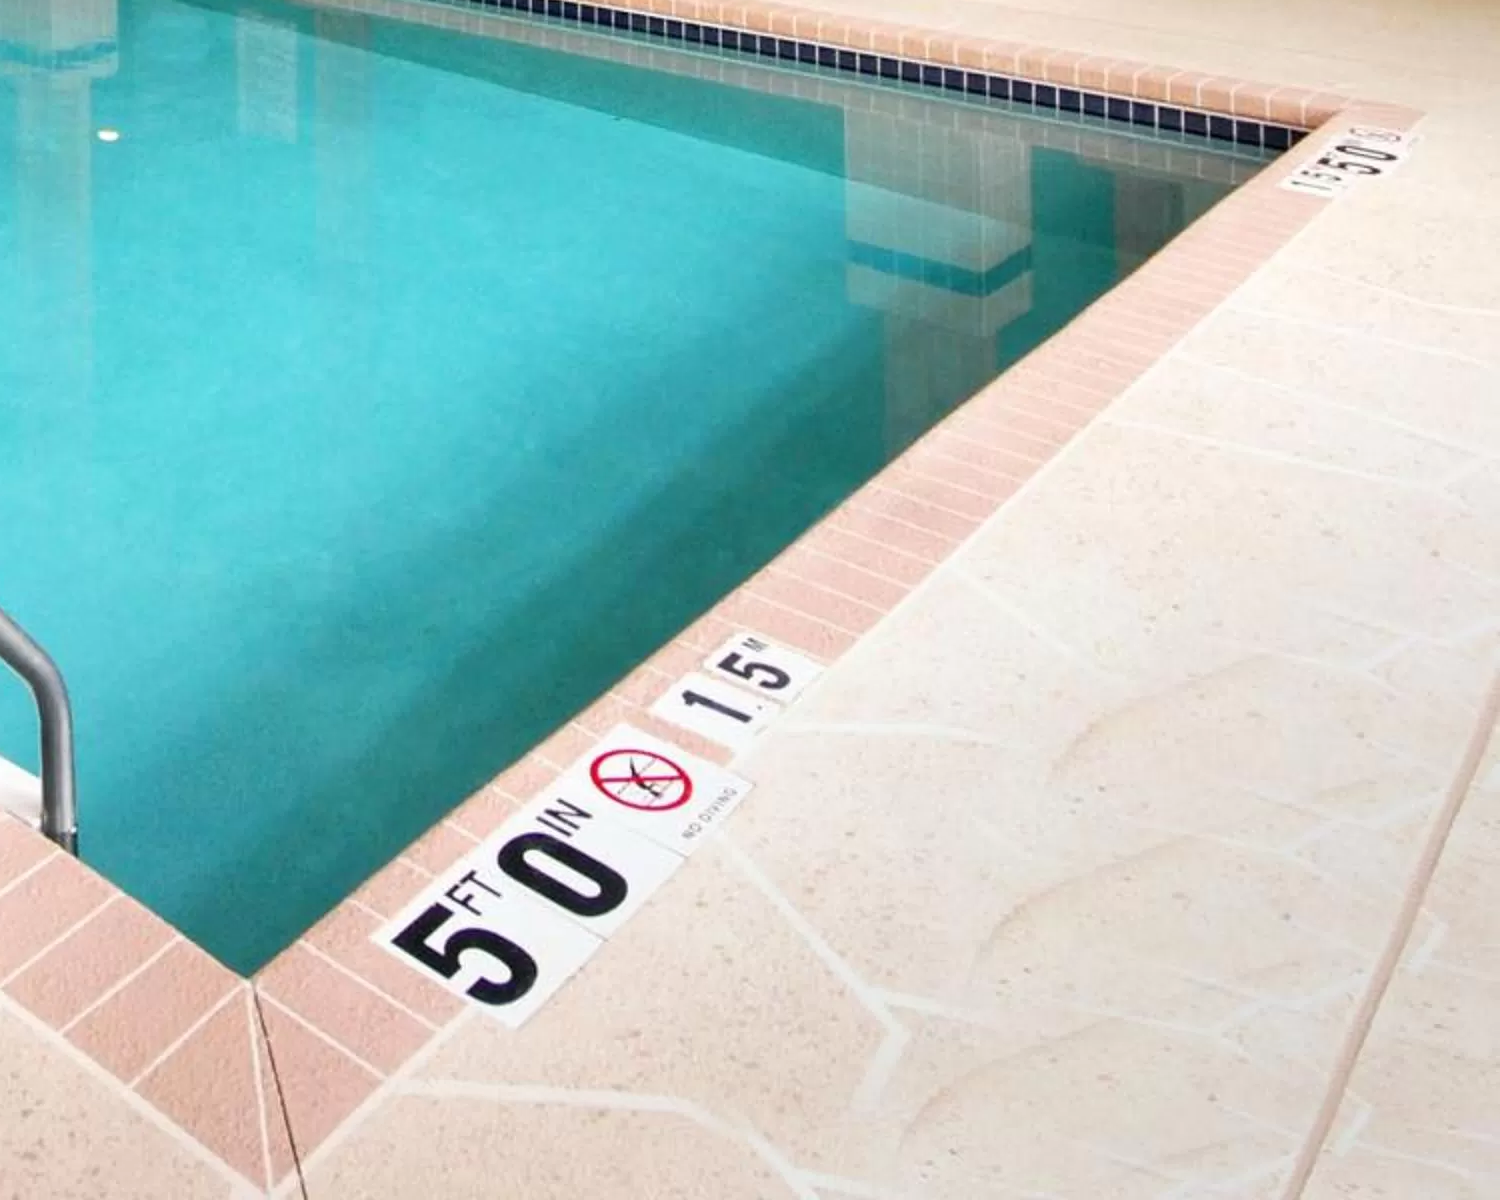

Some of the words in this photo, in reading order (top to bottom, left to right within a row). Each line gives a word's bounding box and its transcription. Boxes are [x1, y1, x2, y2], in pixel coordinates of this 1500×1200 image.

[1316, 157, 1382, 175] 5
[1335, 145, 1399, 161] 0
[536, 798, 593, 837] IN
[681, 821, 703, 839] NO
[698, 787, 739, 823] DIVING
[444, 870, 502, 916] FT
[497, 831, 629, 917] 0
[391, 901, 539, 1006] 5
